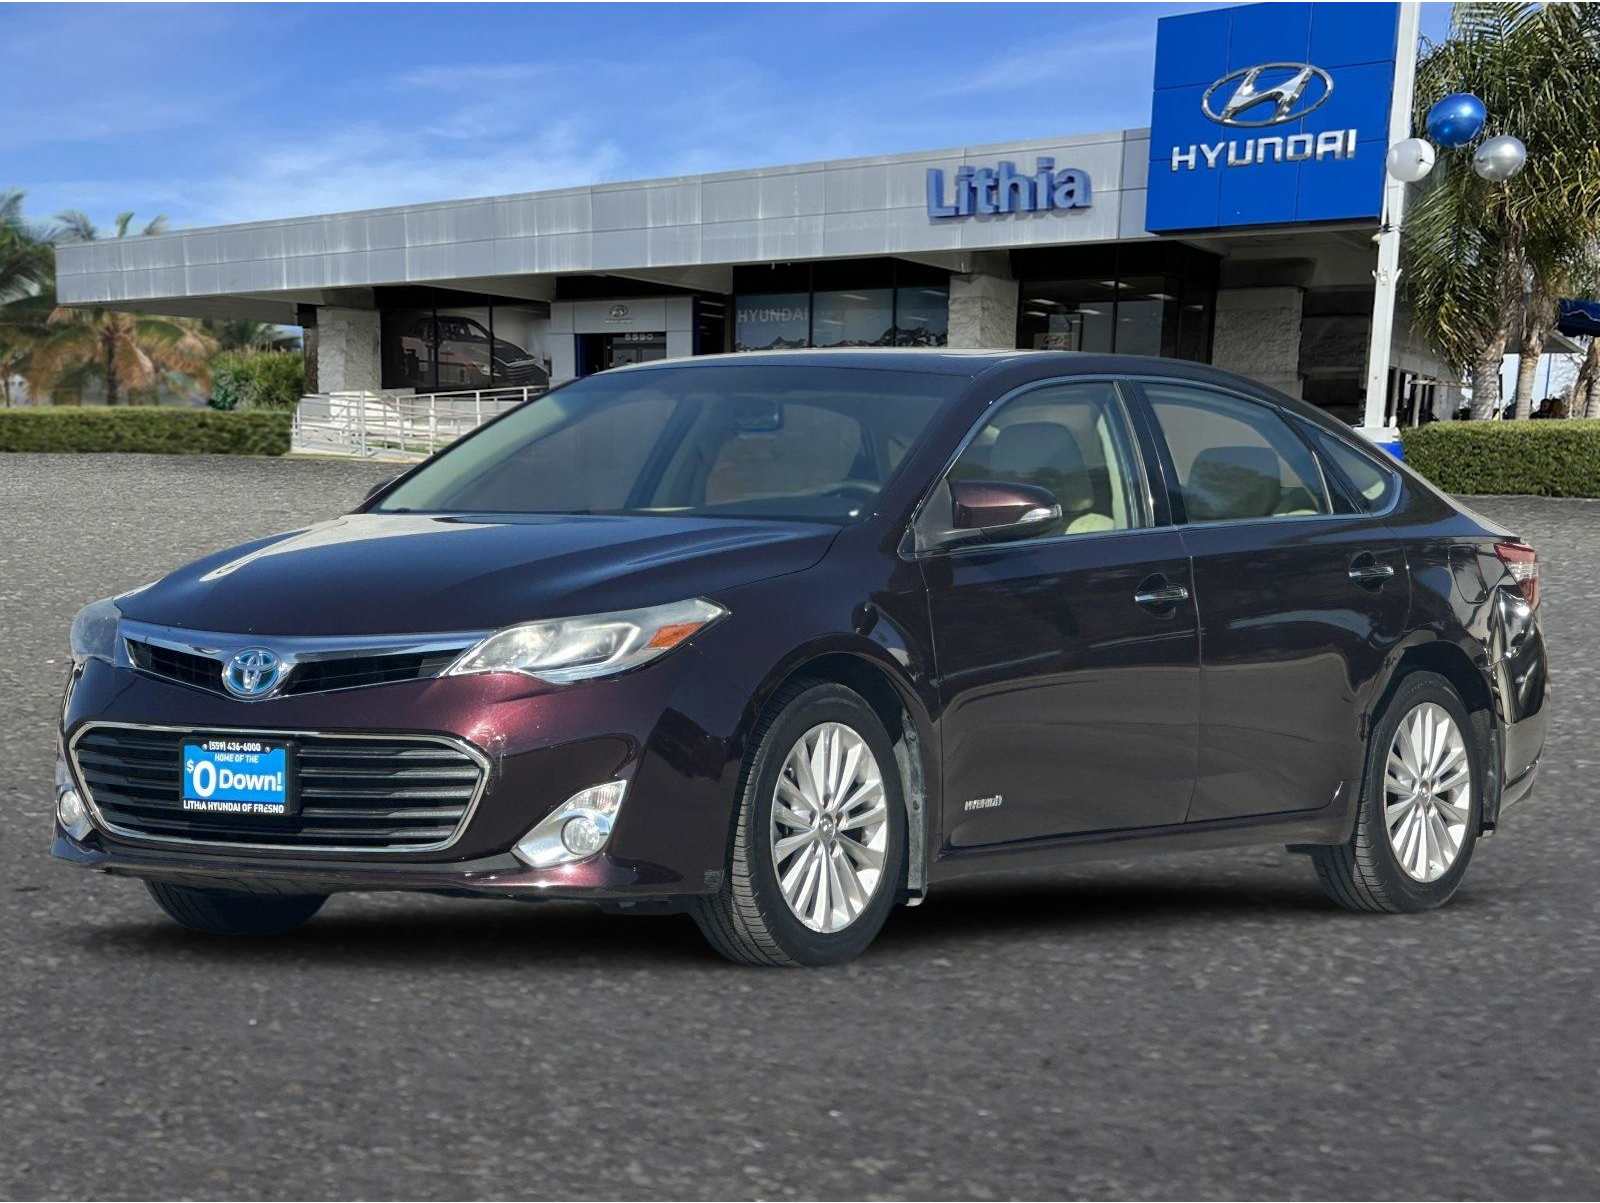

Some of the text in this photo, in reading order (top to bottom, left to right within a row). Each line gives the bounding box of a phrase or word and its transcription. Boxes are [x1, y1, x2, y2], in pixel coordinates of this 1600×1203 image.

[1171, 128, 1357, 172] HYUNDAI
[926, 156, 1093, 218] Lithia
[736, 307, 809, 323] HYUNDAI
[214, 753, 259, 764] HOME OF THE
[220, 768, 284, 792] Down!
[207, 801, 240, 812] HYUNDAI
[241, 803, 252, 812] OF
